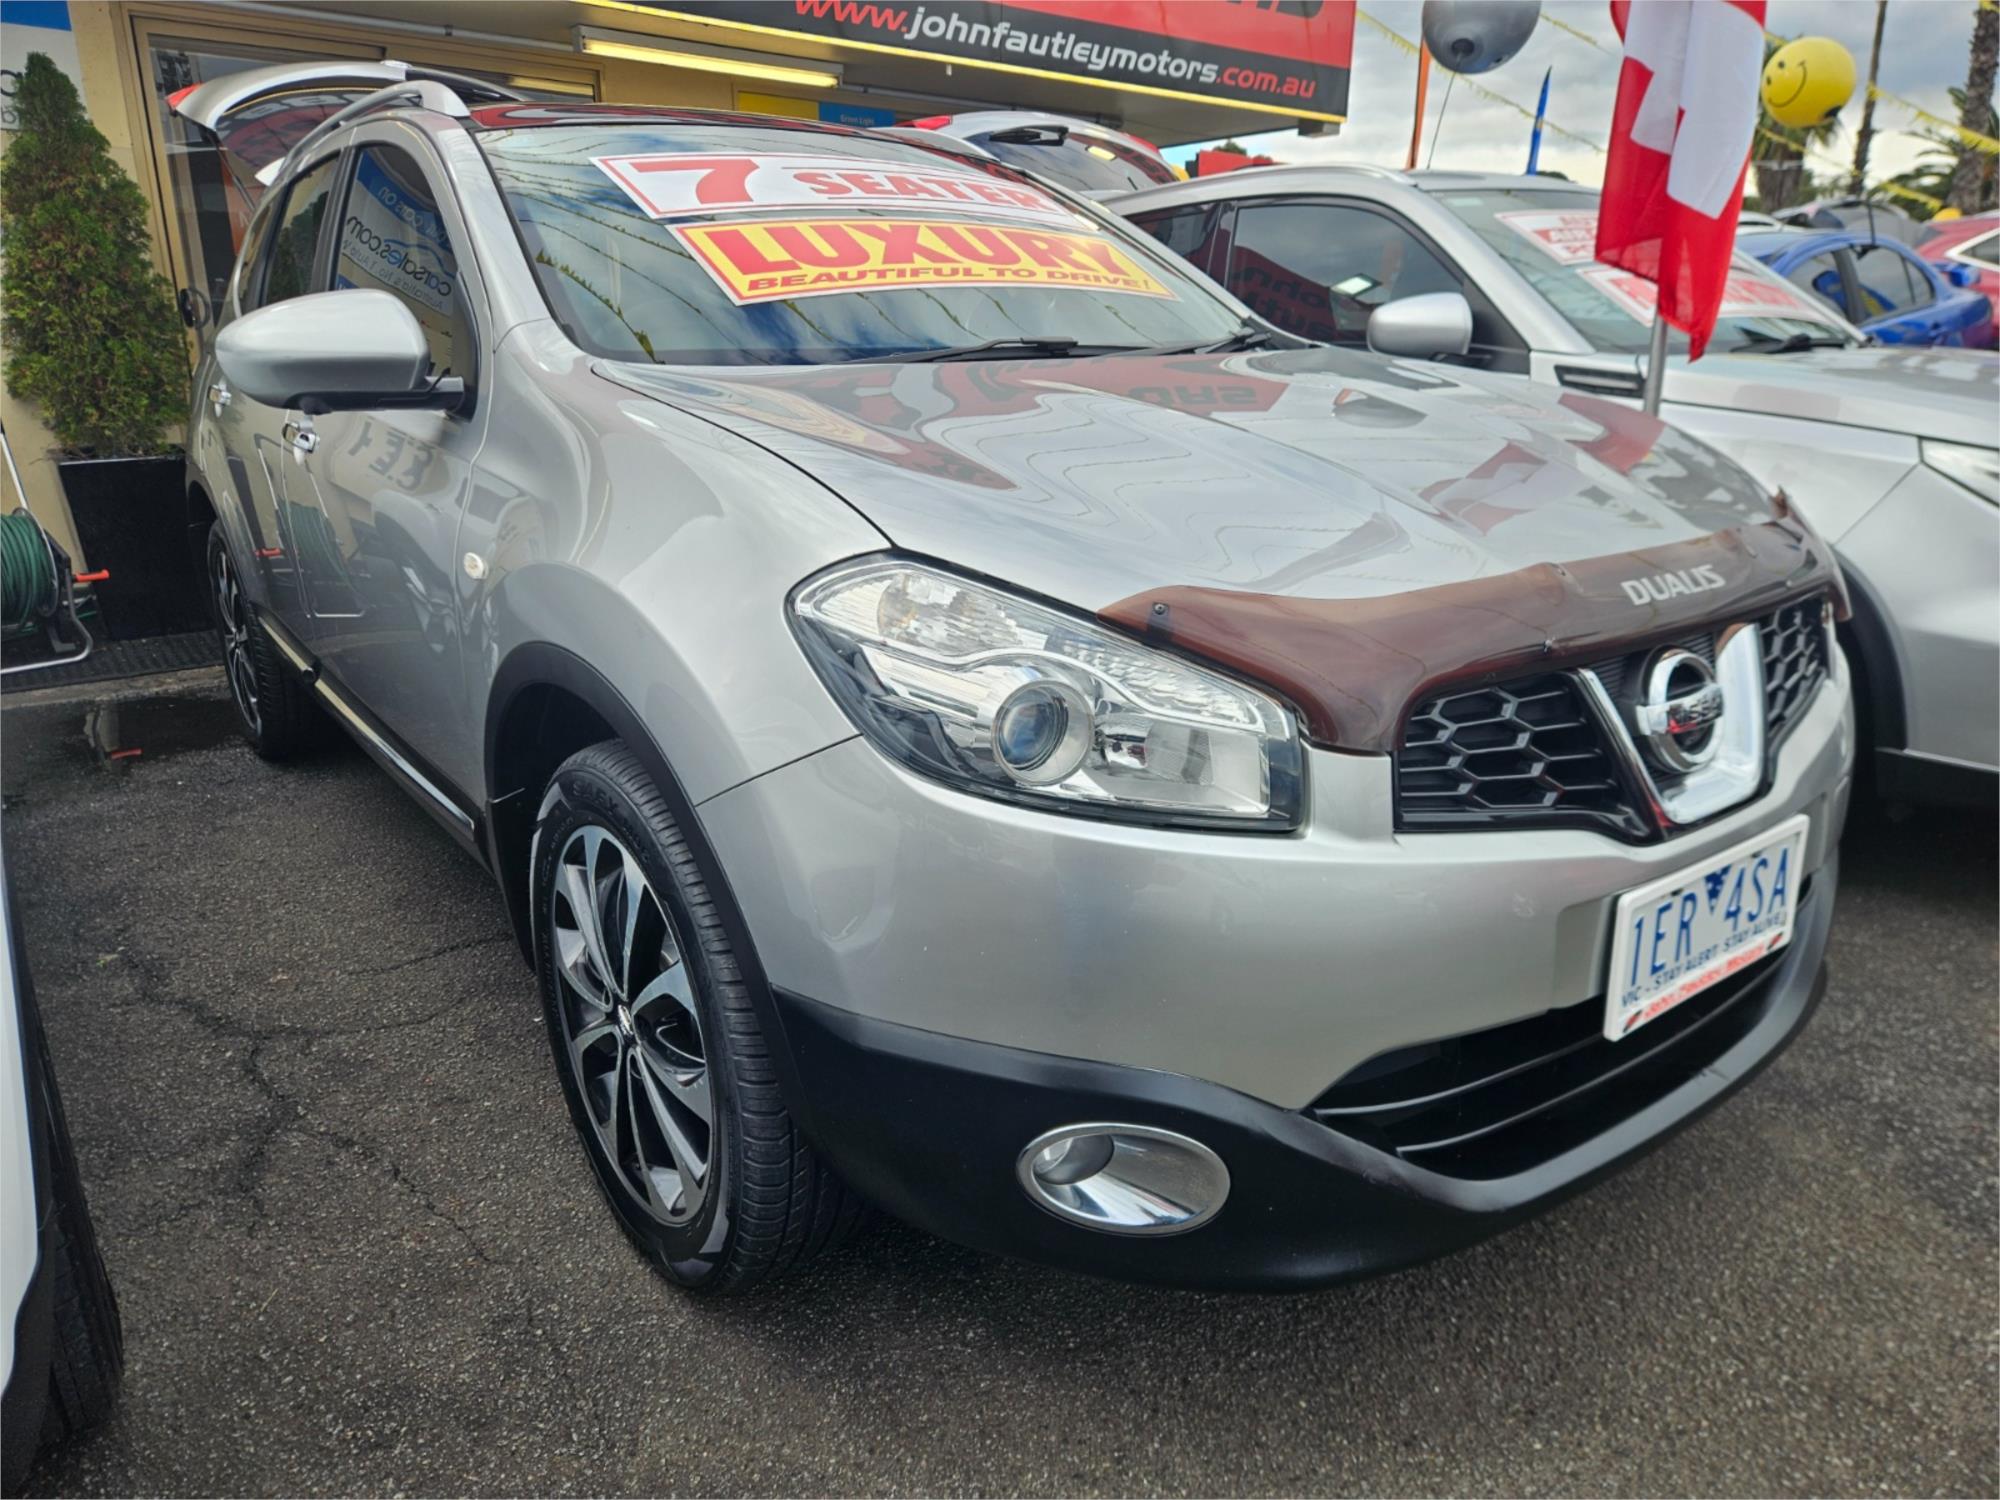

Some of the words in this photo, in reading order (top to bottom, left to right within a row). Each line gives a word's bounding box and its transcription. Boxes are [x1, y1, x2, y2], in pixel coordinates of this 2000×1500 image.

[794, 0, 1316, 98] www.johnfautleymotors.com.au
[629, 158, 760, 205] 7
[793, 172, 1058, 212] SEATER
[704, 223, 1131, 277] LUXURY
[748, 267, 984, 291] BEAUTIFUL
[988, 267, 1037, 279] TO
[1046, 270, 1150, 289] DRIVE!
[1620, 564, 1726, 606] DUALIS
[1631, 891, 1698, 987] 1ER
[1724, 847, 1789, 932] 4SA
